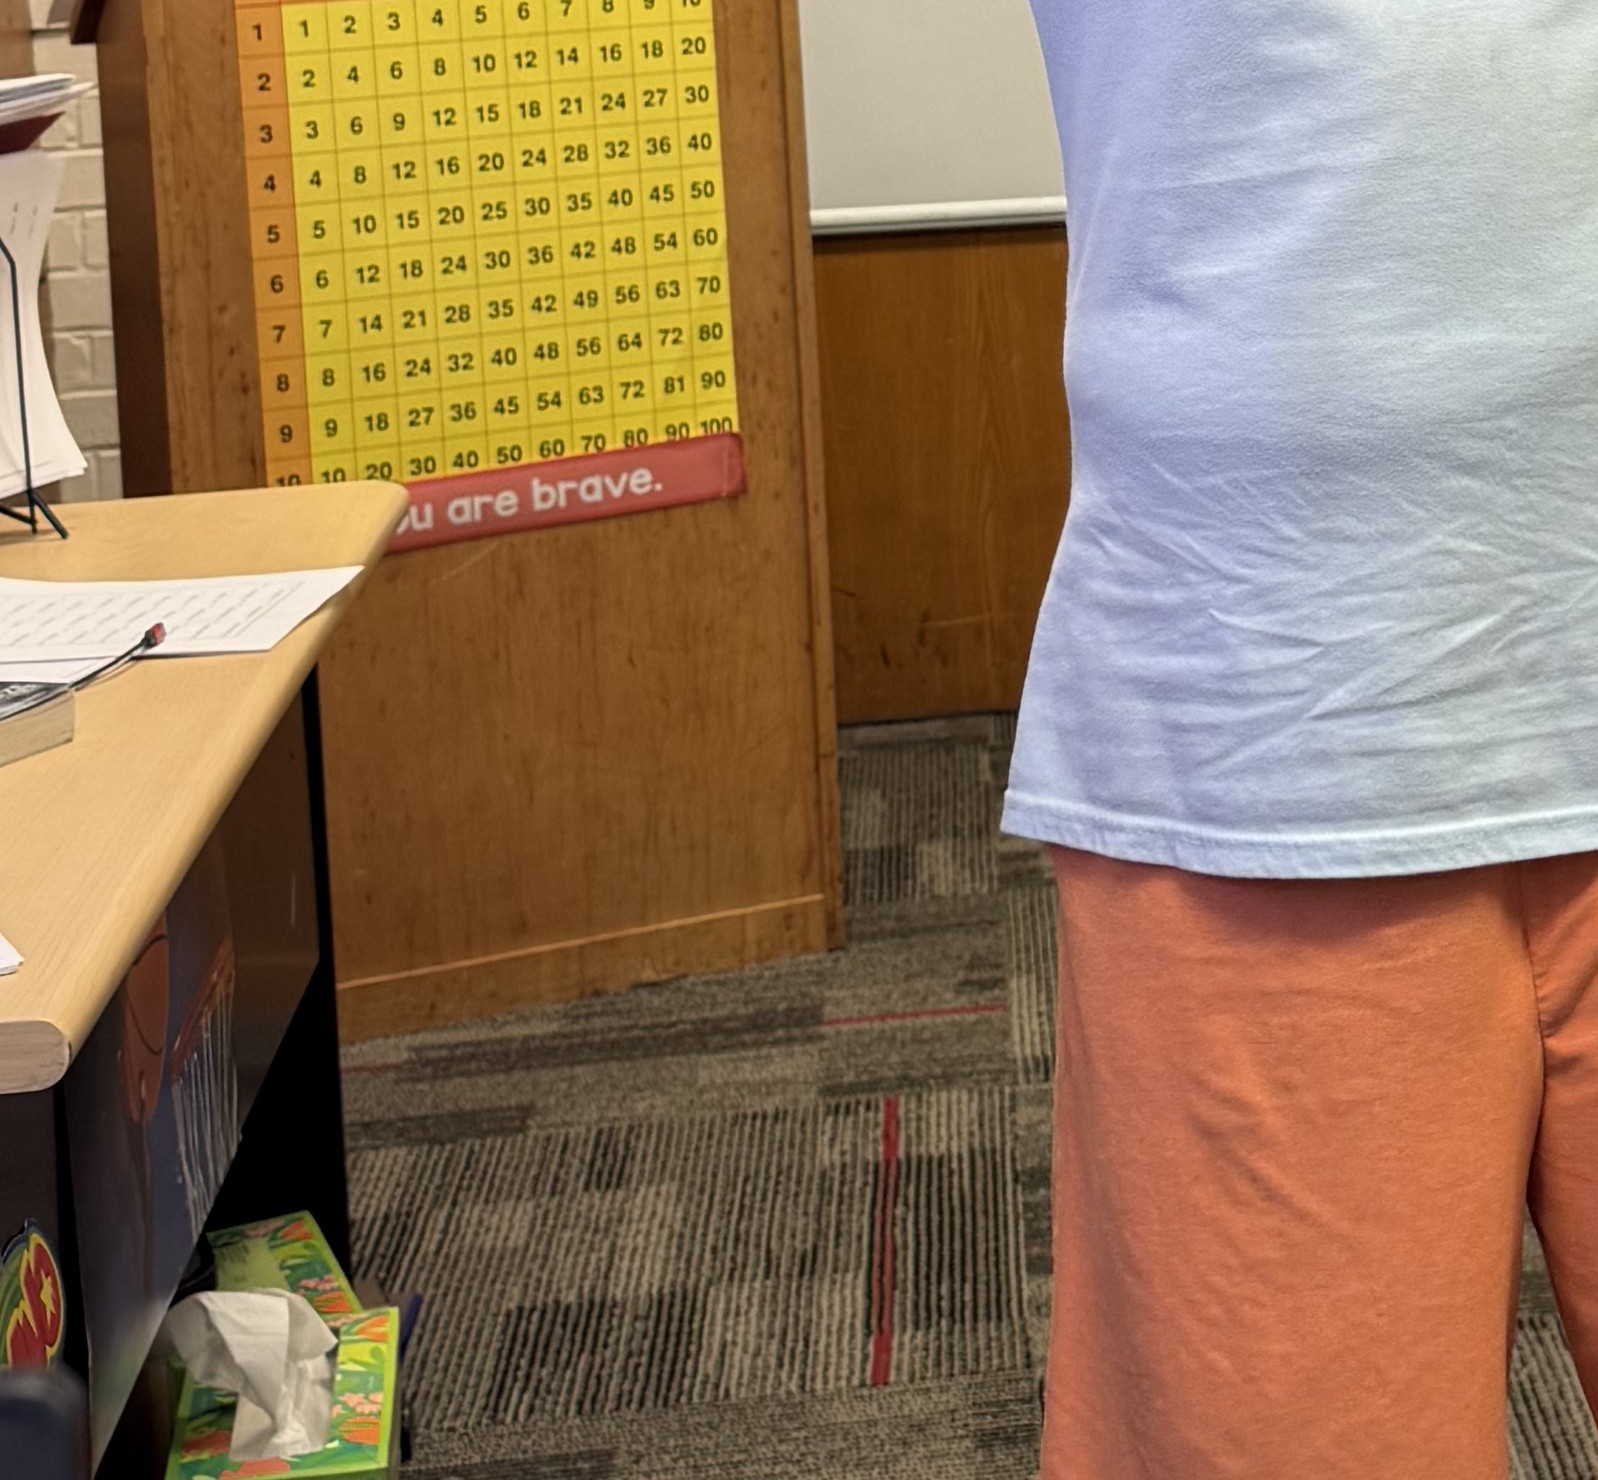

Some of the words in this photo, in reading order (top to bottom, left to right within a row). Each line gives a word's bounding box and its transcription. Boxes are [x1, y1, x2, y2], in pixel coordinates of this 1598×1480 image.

[254, 24, 262, 40] 1
[301, 20, 309, 37] 1
[344, 16, 356, 34] 2
[388, 12, 400, 30] 3
[432, 9, 444, 26] 4
[475, 6, 487, 24] 5
[517, 2, 530, 20] 6
[561, 0, 572, 16] 7
[258, 74, 270, 92] 2
[302, 70, 315, 88] 2
[347, 66, 359, 82] 4
[390, 61, 403, 80] 6
[434, 58, 446, 76] 8
[473, 54, 496, 72] 10
[514, 50, 536, 68] 12
[557, 48, 578, 65] 14
[600, 44, 622, 62] 16
[641, 41, 664, 58] 18
[682, 37, 706, 55] 20
[260, 125, 273, 143] 3
[306, 120, 319, 139] 3
[350, 116, 363, 134] 6
[392, 113, 406, 131] 9
[433, 108, 456, 126] 12
[476, 104, 499, 122] 15
[519, 101, 541, 119] 18
[560, 97, 582, 115] 21
[602, 92, 626, 112] 24
[643, 88, 667, 108] 27
[685, 85, 709, 104] 30
[263, 175, 276, 192] 4
[309, 170, 322, 187] 4
[354, 166, 367, 184] 8
[392, 161, 416, 179] 12
[437, 157, 460, 175] 16
[478, 153, 504, 172] 20
[522, 149, 546, 168] 24
[564, 145, 588, 163] 28
[605, 140, 629, 159] 32
[646, 137, 671, 155] 36
[688, 133, 712, 150] 40
[267, 225, 280, 244] 5
[313, 220, 326, 239] 5
[353, 215, 376, 234] 10
[396, 210, 419, 229] 15
[438, 206, 464, 226] 20
[481, 202, 507, 221] 25
[525, 197, 550, 216] 30
[568, 193, 592, 212] 35
[608, 189, 633, 206] 40
[649, 184, 674, 202] 45
[691, 180, 714, 199] 50
[270, 275, 284, 293] 6
[315, 270, 329, 288] 6
[356, 265, 380, 284] 12
[400, 260, 423, 278] 18
[441, 255, 467, 275] 24
[485, 250, 511, 270] 30
[528, 246, 553, 265] 36
[570, 241, 595, 259] 42
[611, 237, 636, 254] 48
[654, 232, 678, 251] 54
[693, 228, 718, 246] 60
[273, 325, 285, 343] 7
[320, 320, 332, 338] 7
[360, 314, 382, 333] 14
[403, 310, 426, 329] 21
[445, 305, 470, 324] 28
[488, 299, 513, 318] 35
[531, 295, 556, 313] 42
[573, 290, 598, 307] 49
[615, 286, 640, 304] 56
[655, 280, 680, 298] 63
[698, 276, 720, 294] 70
[276, 374, 290, 392] 8
[322, 369, 335, 386] 8
[362, 364, 386, 382] 16
[406, 358, 431, 378] 24
[448, 353, 473, 372] 32
[491, 348, 517, 366] 40
[534, 342, 559, 360] 48
[576, 338, 601, 356] 56
[617, 333, 642, 351] 64
[659, 328, 682, 346] 72
[698, 322, 723, 342] 80
[280, 425, 293, 443] 9
[324, 419, 338, 438] 9
[366, 414, 390, 432] 18
[408, 407, 434, 427] 27
[451, 404, 476, 422] 36
[494, 397, 519, 415] 45
[537, 392, 562, 411] 54
[578, 386, 604, 404] 63
[621, 380, 644, 399] 72
[664, 376, 684, 394] 81
[701, 371, 726, 388] 90
[322, 468, 346, 484] 10
[366, 462, 392, 481] 20
[410, 456, 436, 476] 30
[452, 451, 479, 468] 40
[497, 445, 522, 464] 50
[539, 439, 565, 458] 60
[582, 434, 606, 451] 70
[623, 428, 649, 447] 80
[665, 422, 690, 439] 90
[701, 417, 733, 433] 100
[446, 489, 519, 526] are
[531, 467, 664, 513] brave.
